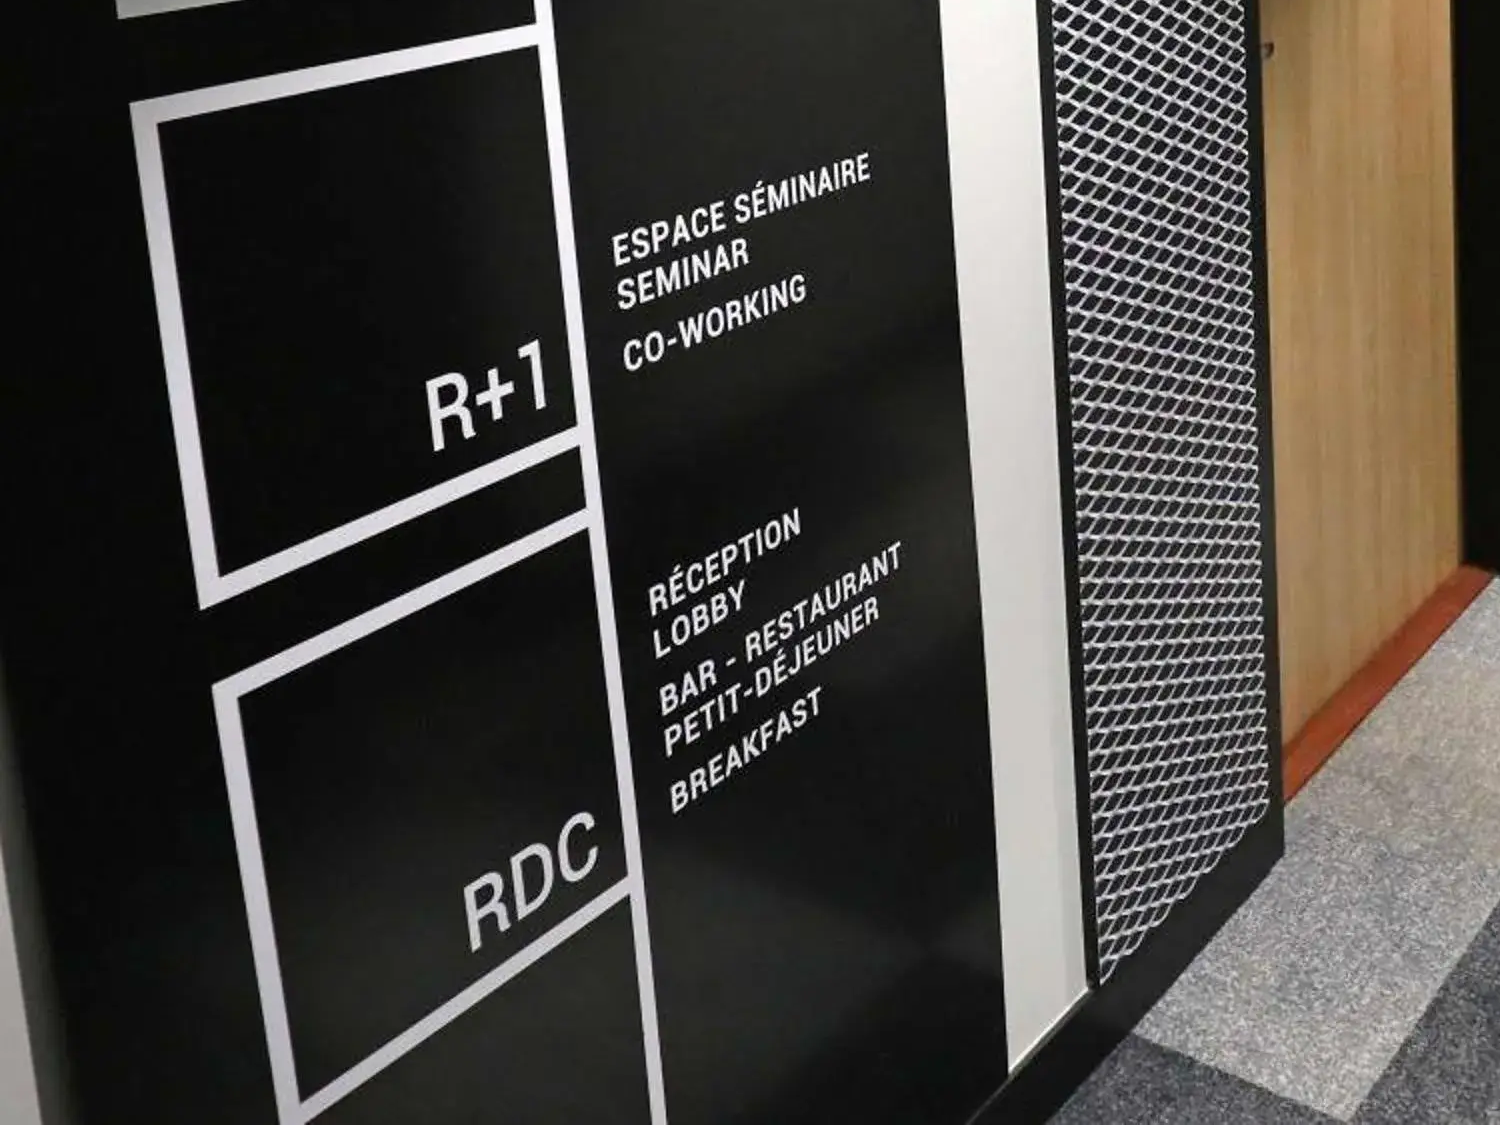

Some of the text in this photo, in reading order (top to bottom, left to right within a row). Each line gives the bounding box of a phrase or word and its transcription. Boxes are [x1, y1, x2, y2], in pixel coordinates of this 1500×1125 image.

[611, 152, 871, 267] ESPACE SÉMINAIRE
[617, 237, 750, 310] SEMINAR
[623, 274, 806, 372] CO-WORKING
[425, 339, 547, 452] R+1
[648, 507, 801, 617] RÉCEPTION
[653, 579, 746, 659] LOBBY
[659, 659, 717, 716] BAR
[745, 540, 901, 663] RESTAURANT
[663, 596, 879, 757] PETIT-DÉJEUNER
[670, 686, 822, 814] BREAKFAST
[463, 811, 598, 953] RDC
